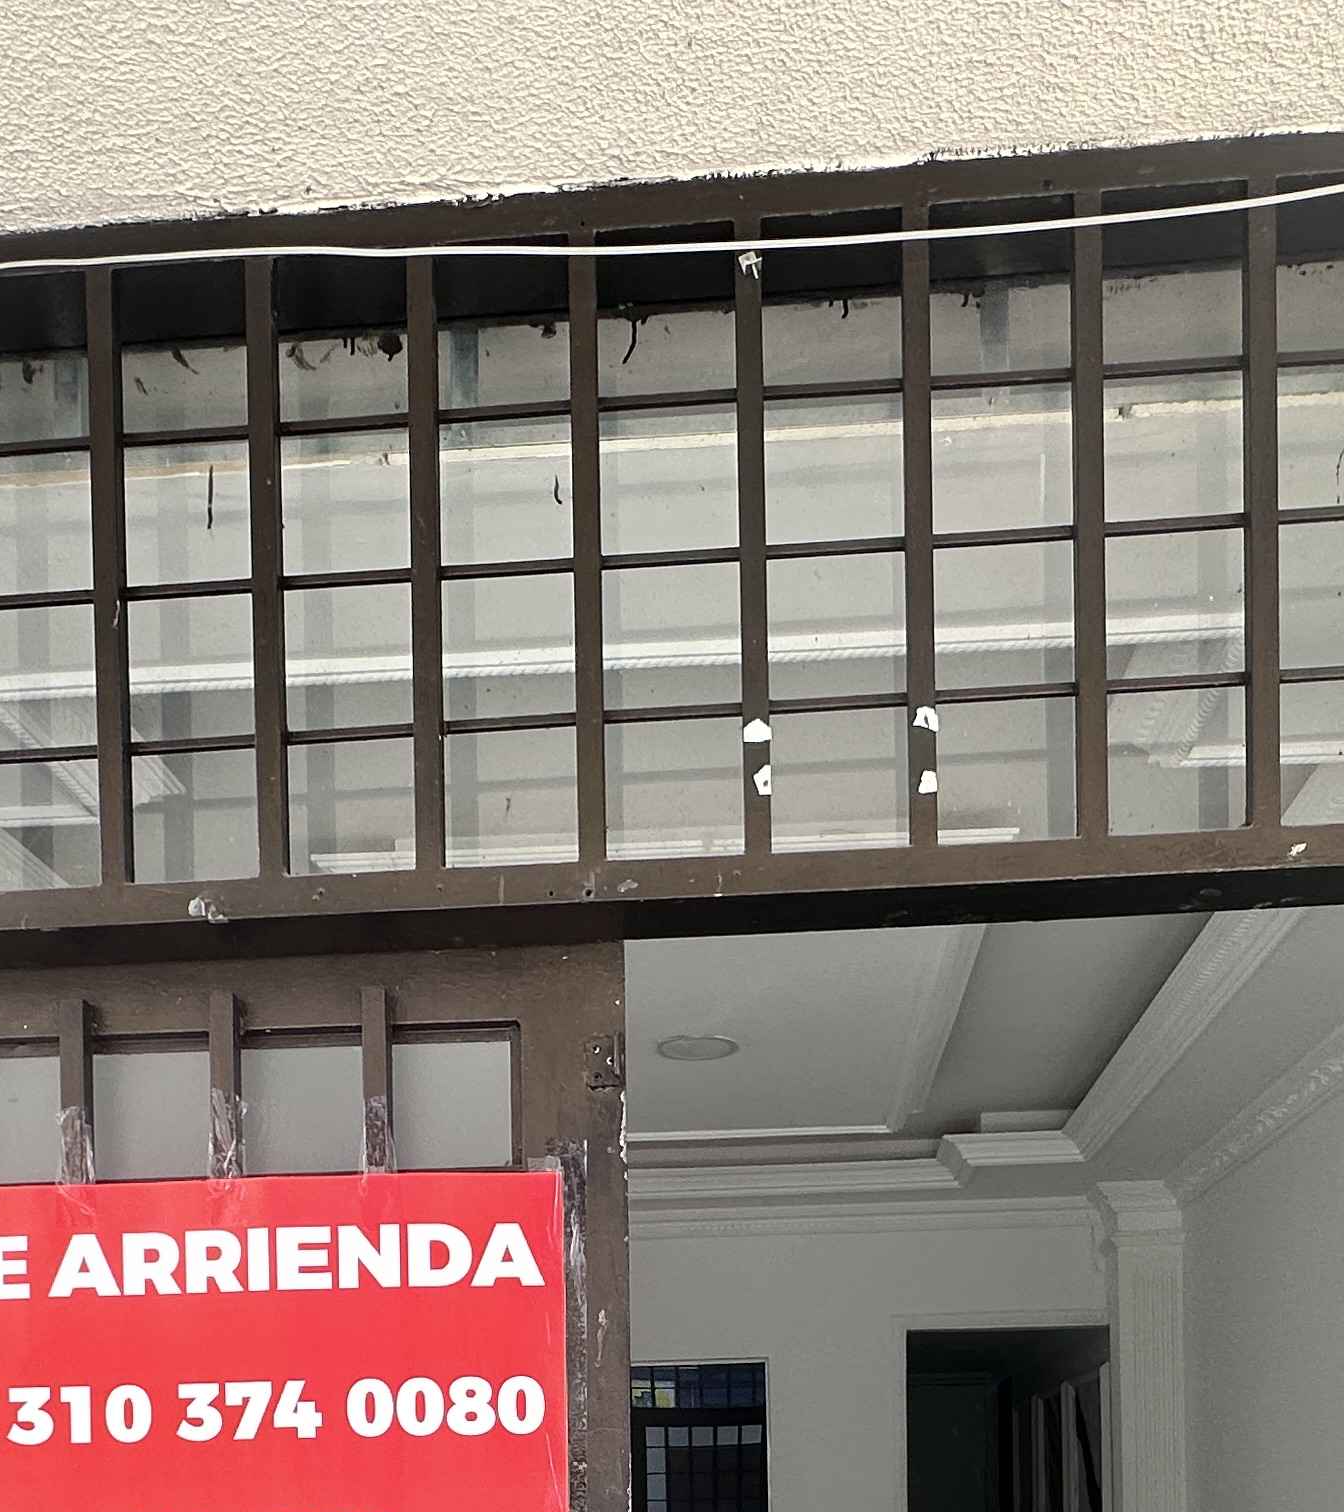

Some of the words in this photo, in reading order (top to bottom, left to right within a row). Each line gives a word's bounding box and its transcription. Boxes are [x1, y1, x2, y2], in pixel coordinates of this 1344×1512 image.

[47, 1221, 546, 1298] ARRIENDA
[6, 1383, 153, 1446] 310
[175, 1379, 323, 1442] 374
[345, 1374, 546, 1438] 0080
